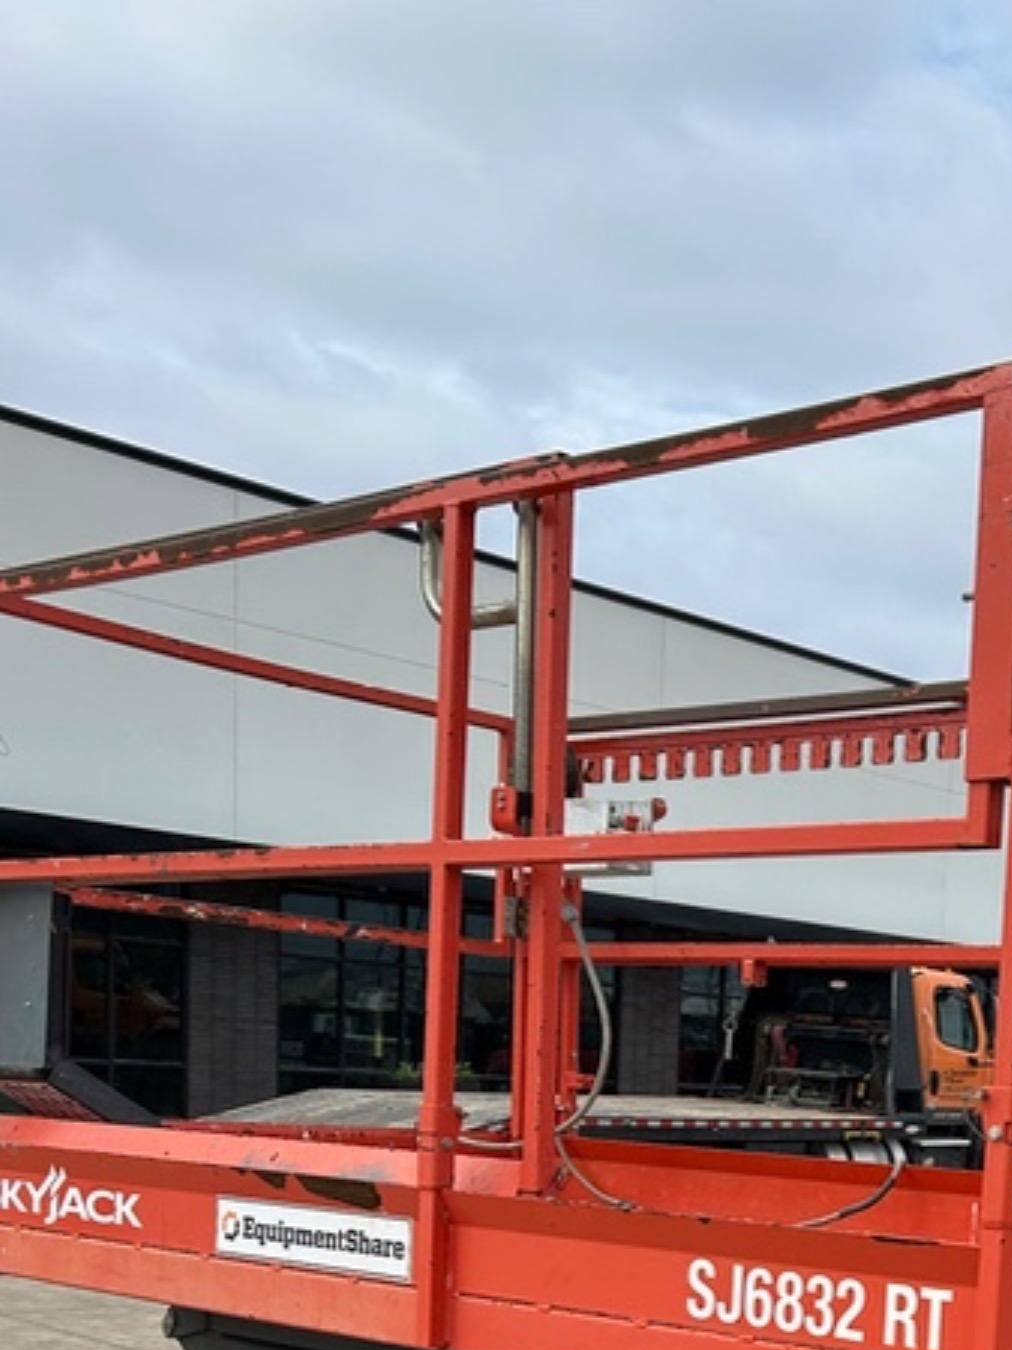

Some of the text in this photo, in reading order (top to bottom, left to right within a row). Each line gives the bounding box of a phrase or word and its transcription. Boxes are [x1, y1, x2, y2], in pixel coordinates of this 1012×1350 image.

[0, 1165, 142, 1228] KYJACK
[242, 1217, 405, 1260] EquipmentShare
[686, 1258, 865, 1342] SJ6832
